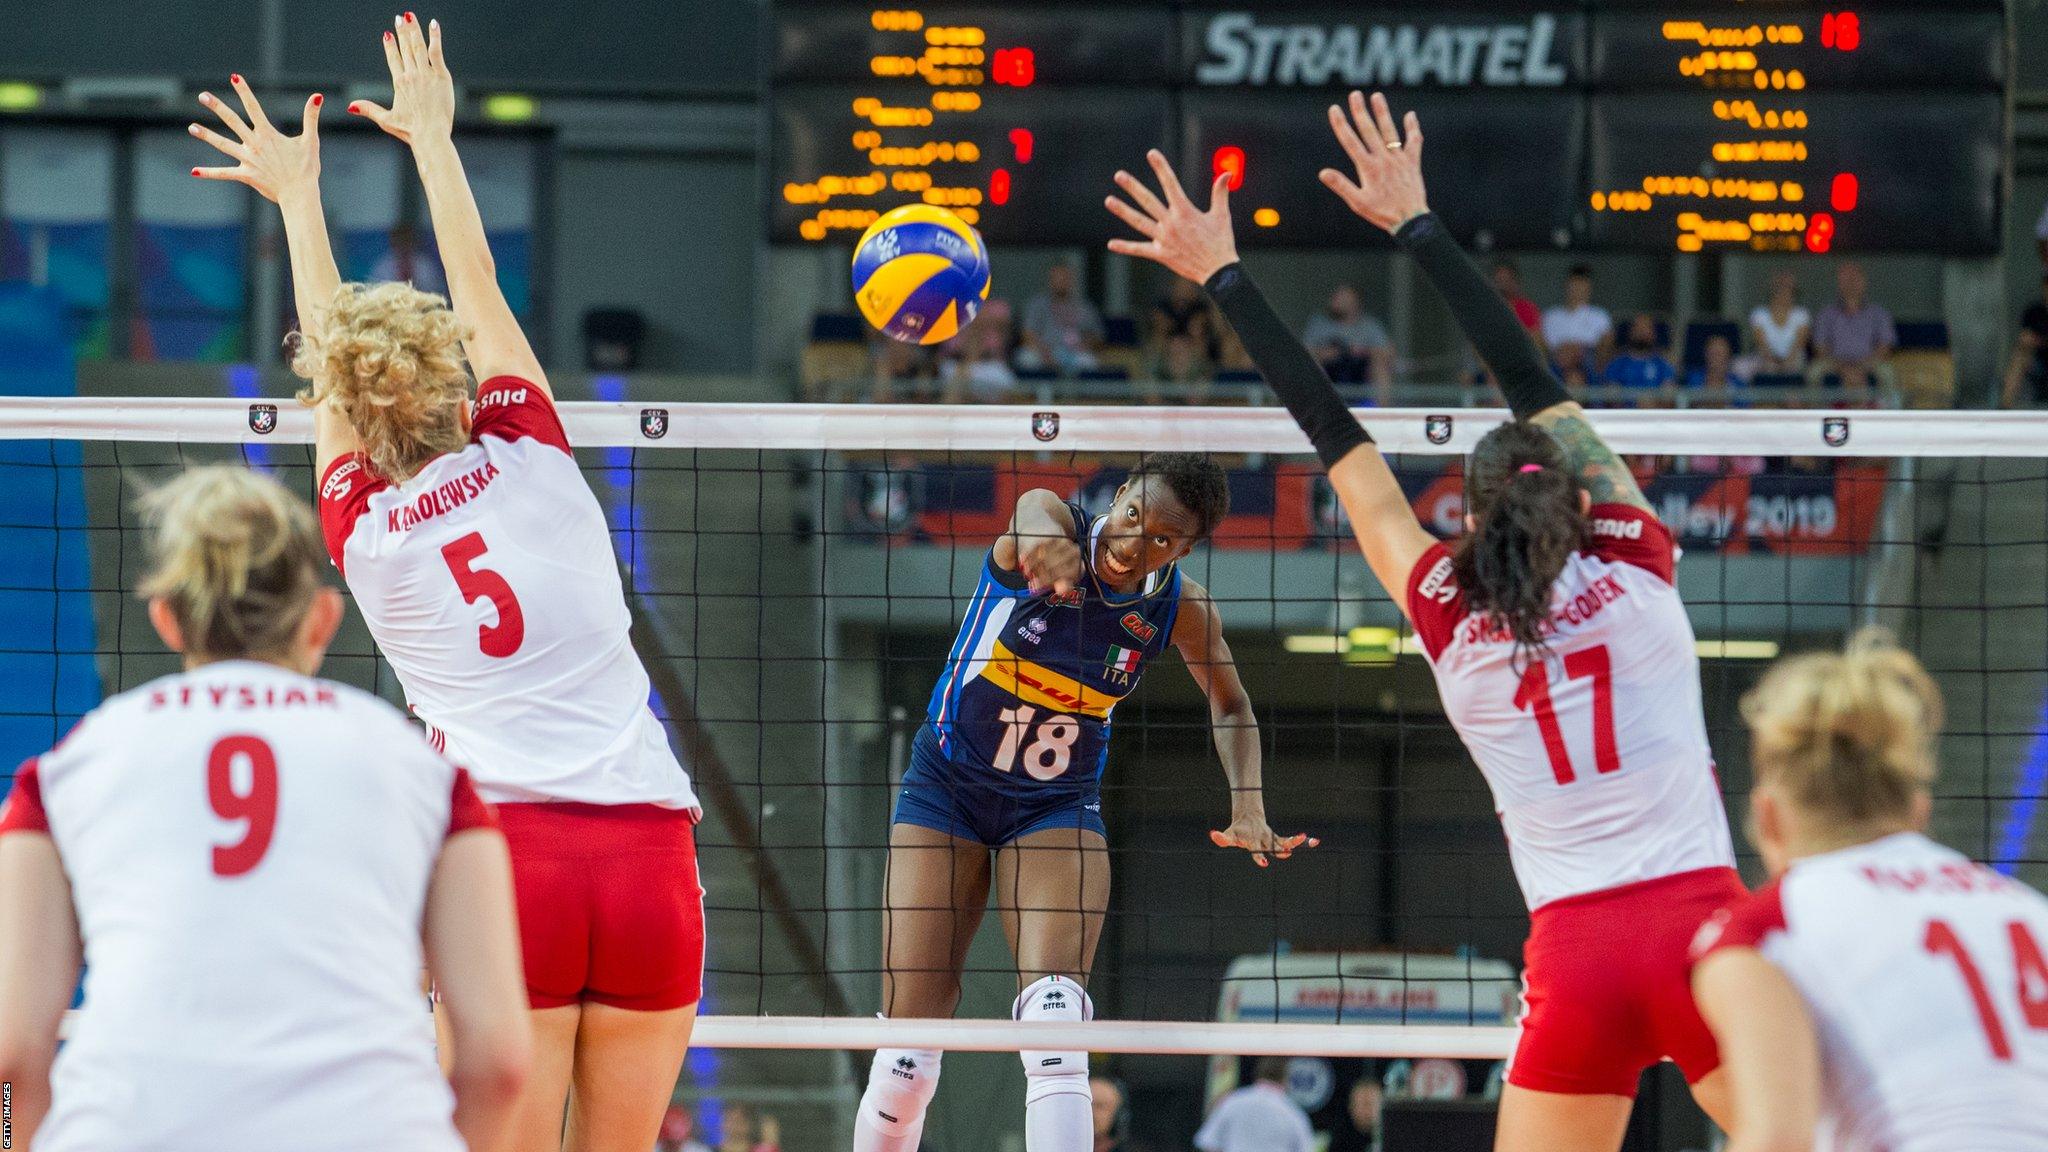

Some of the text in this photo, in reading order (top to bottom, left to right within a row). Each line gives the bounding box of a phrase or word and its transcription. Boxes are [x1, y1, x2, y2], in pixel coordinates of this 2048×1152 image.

[1196, 12, 1567, 86] STRAMATEL
[481, 387, 528, 409] plus
[1744, 495, 1838, 537] 2019
[441, 531, 524, 658] 5
[1102, 667, 1129, 686] ITA
[992, 703, 1080, 782] 18
[1513, 644, 1620, 786] 17
[206, 732, 279, 877] 9
[1042, 1000, 1066, 1010] errea
[1924, 919, 2048, 1061] 14
[891, 1068, 915, 1081] errea
